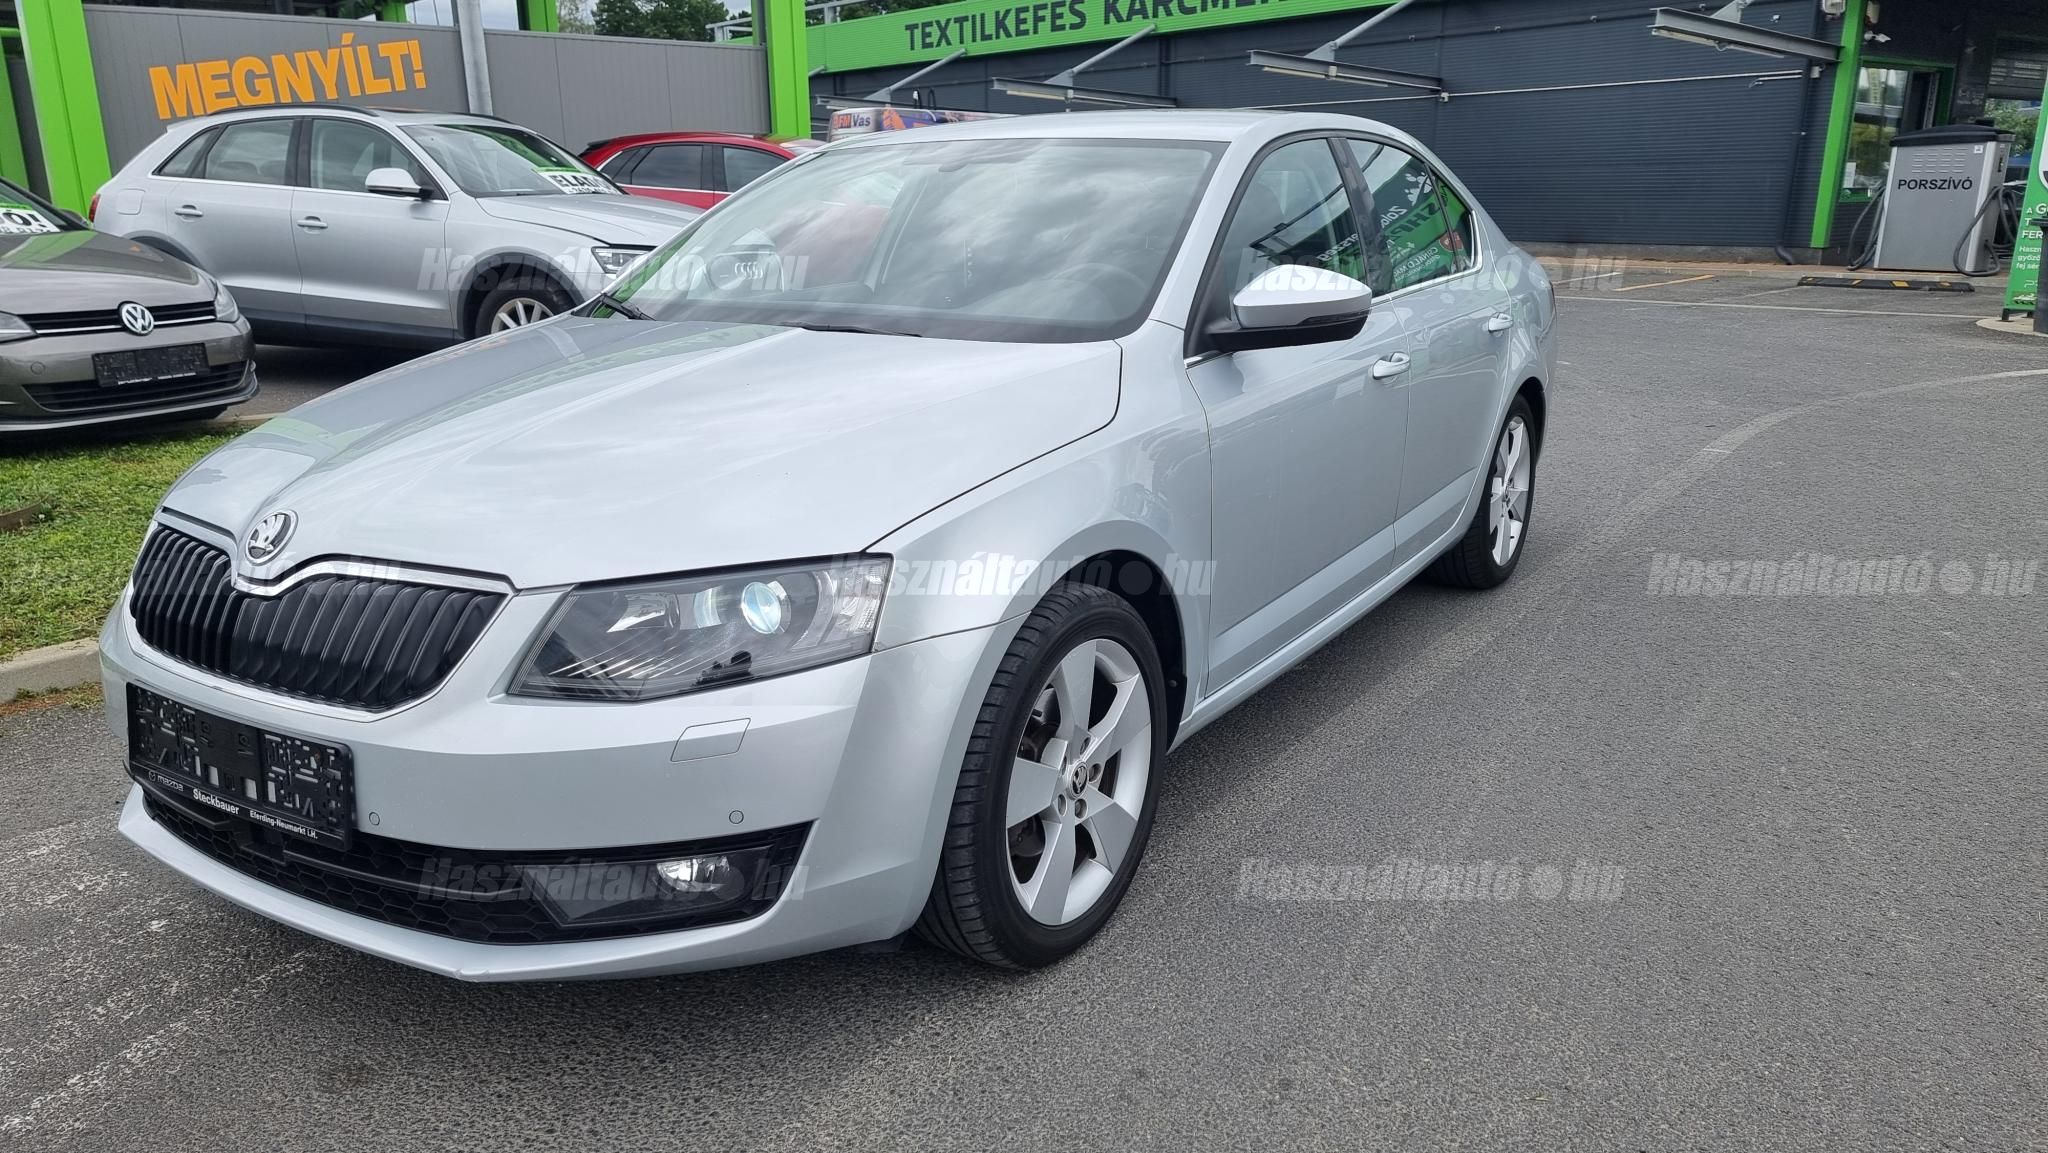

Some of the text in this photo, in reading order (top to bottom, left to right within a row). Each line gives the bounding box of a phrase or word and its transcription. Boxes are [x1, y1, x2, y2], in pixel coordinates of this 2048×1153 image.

[905, 0, 1087, 51] TEXTILKEFES
[149, 32, 427, 120] MEGNYÍLT!
[853, 113, 871, 128] Vas
[1898, 176, 1973, 190] PORSZÍVÓ
[2036, 203, 2048, 214] G
[2022, 230, 2044, 239] FER
[193, 788, 240, 815] Steckbauer
[250, 810, 306, 836] Eferding-Neumarkt
